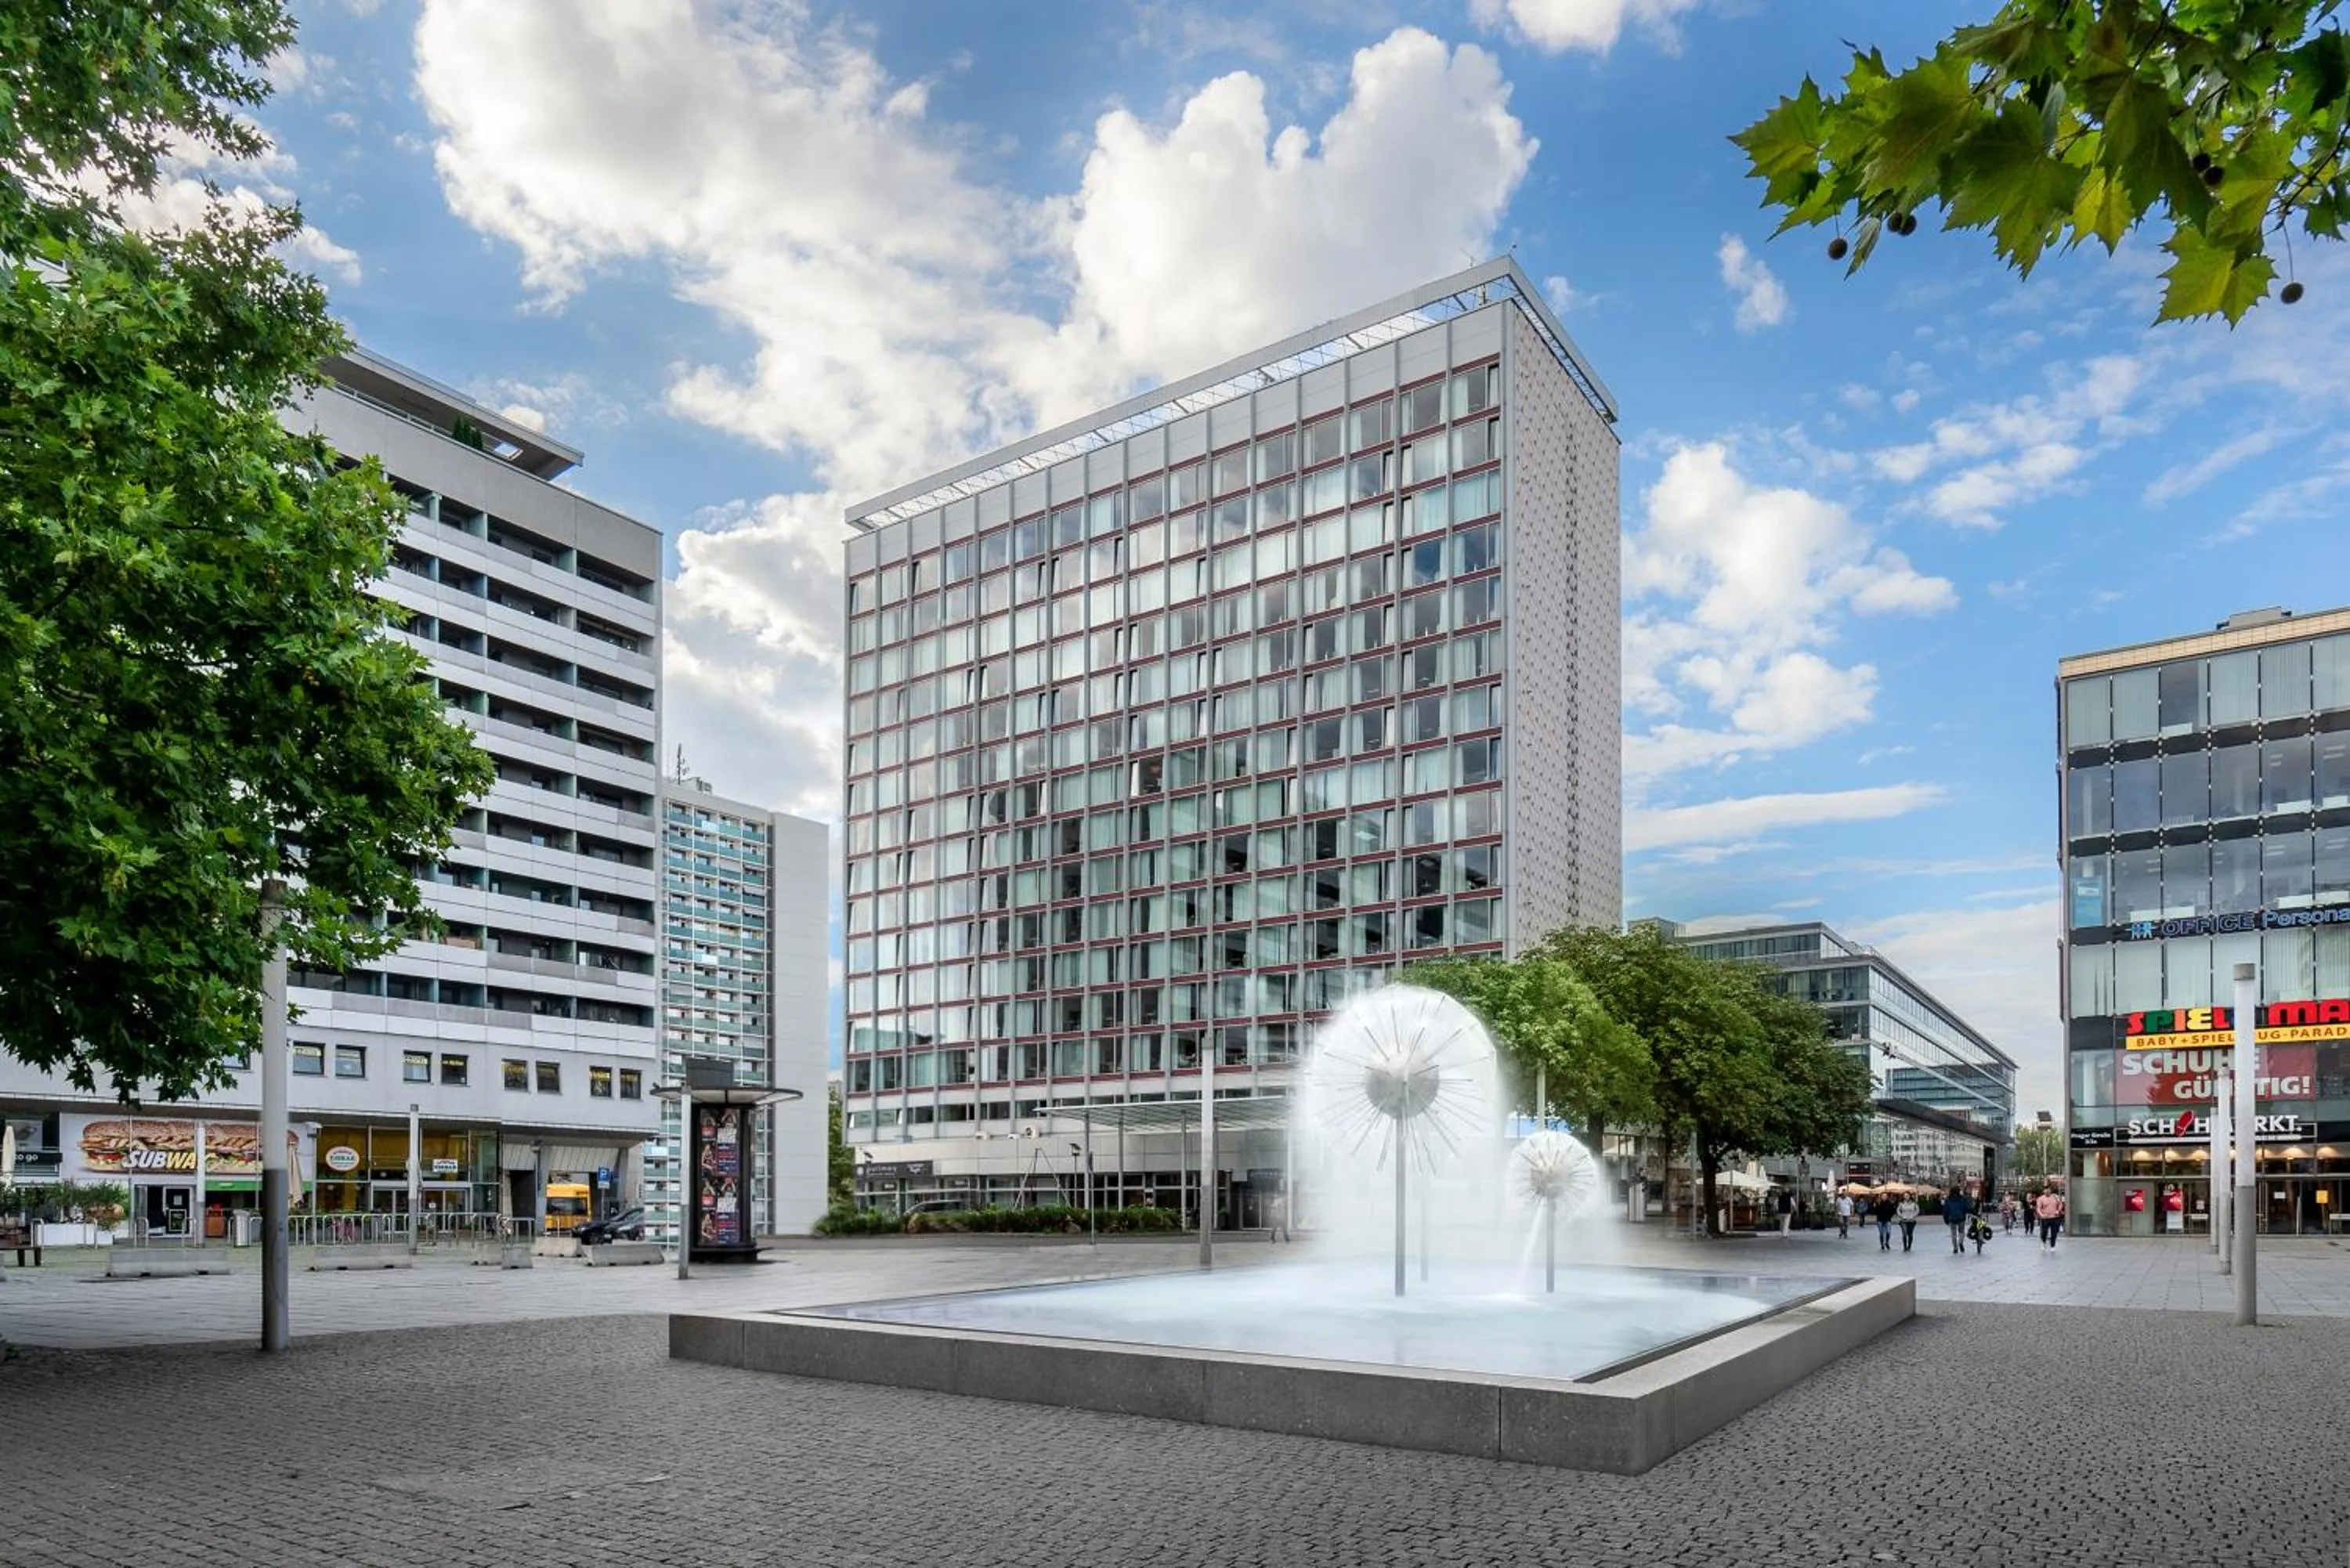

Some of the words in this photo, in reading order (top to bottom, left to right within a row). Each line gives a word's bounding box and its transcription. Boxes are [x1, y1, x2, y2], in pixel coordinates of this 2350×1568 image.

[2162, 914, 2255, 936] OFFICE
[2126, 1007, 2235, 1035] SPIEL
[2193, 1028, 2348, 1044] SPIELUG-PARAD
[2174, 1075, 2310, 1100] GÜTIG!
[25, 1154, 38, 1163] go
[122, 1151, 198, 1169] SUBWA
